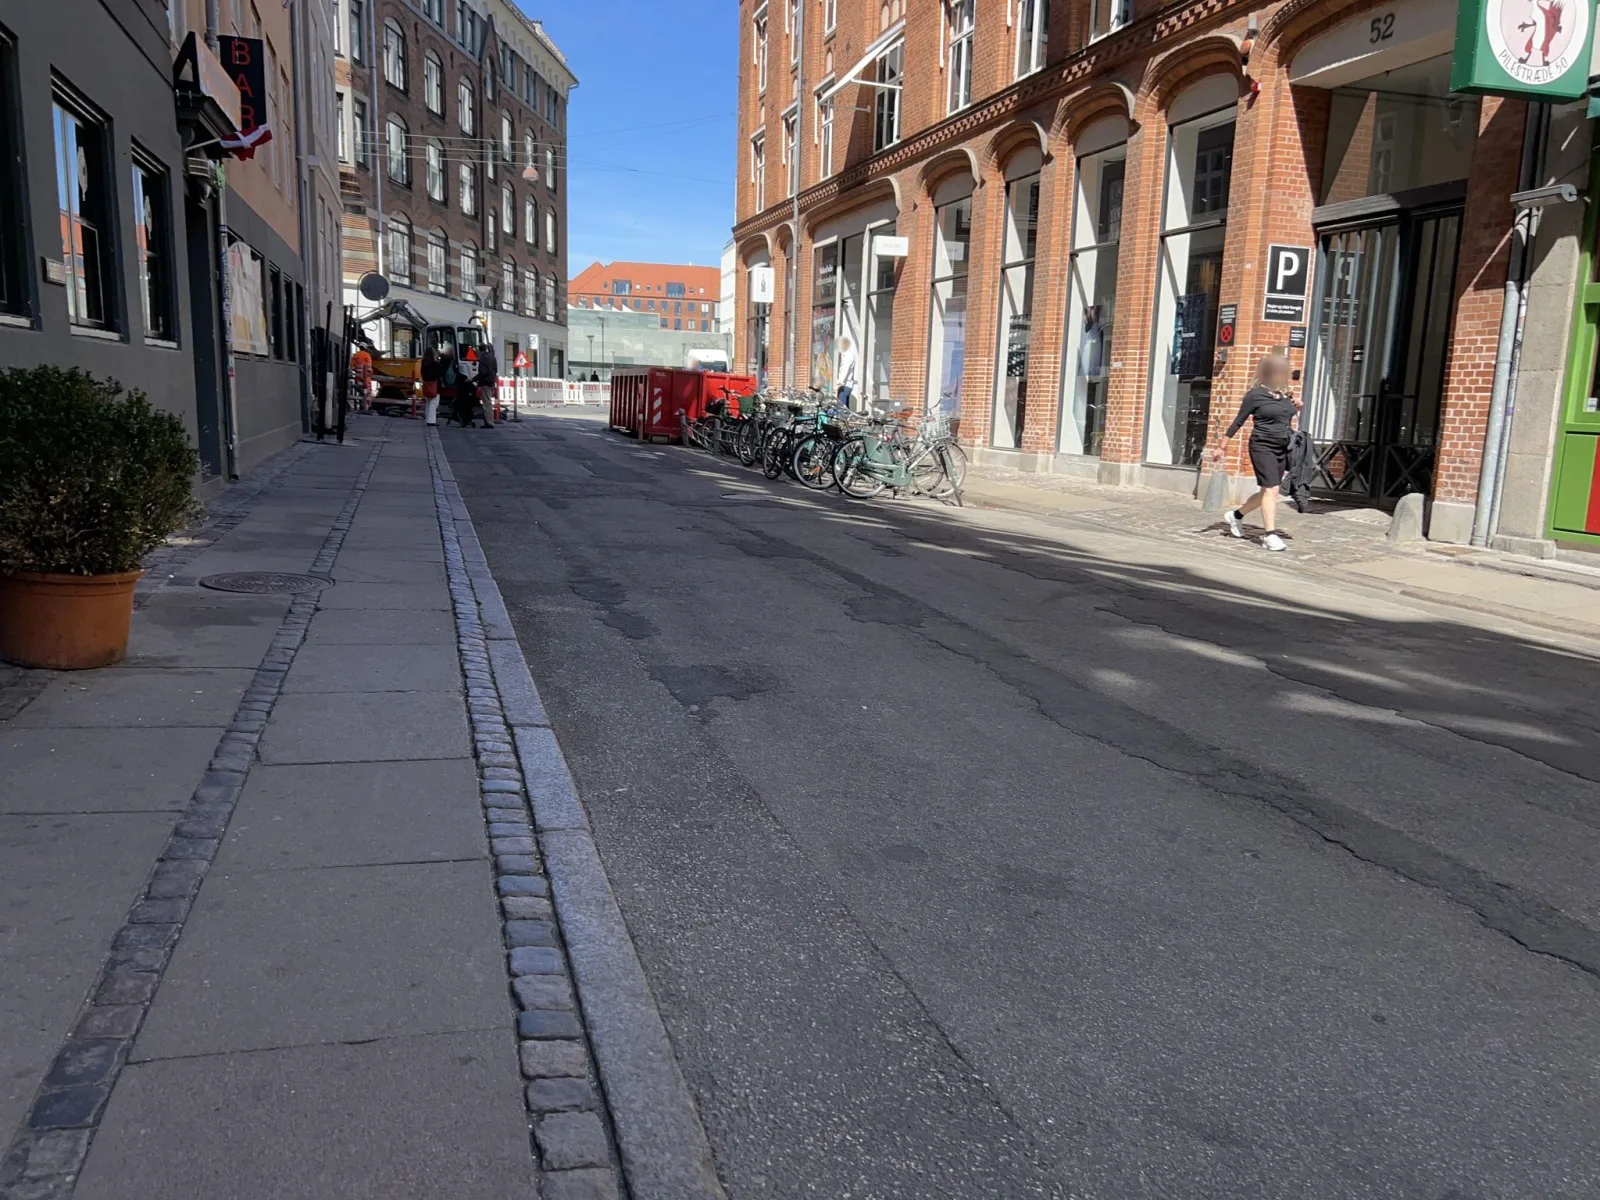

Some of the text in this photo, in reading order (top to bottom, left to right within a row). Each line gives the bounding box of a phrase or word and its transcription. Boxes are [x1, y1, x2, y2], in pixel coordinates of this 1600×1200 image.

[1369, 12, 1395, 44] 52
[1498, 49, 1568, 83] PILESTRÆDE 50
[1276, 250, 1299, 290] P
